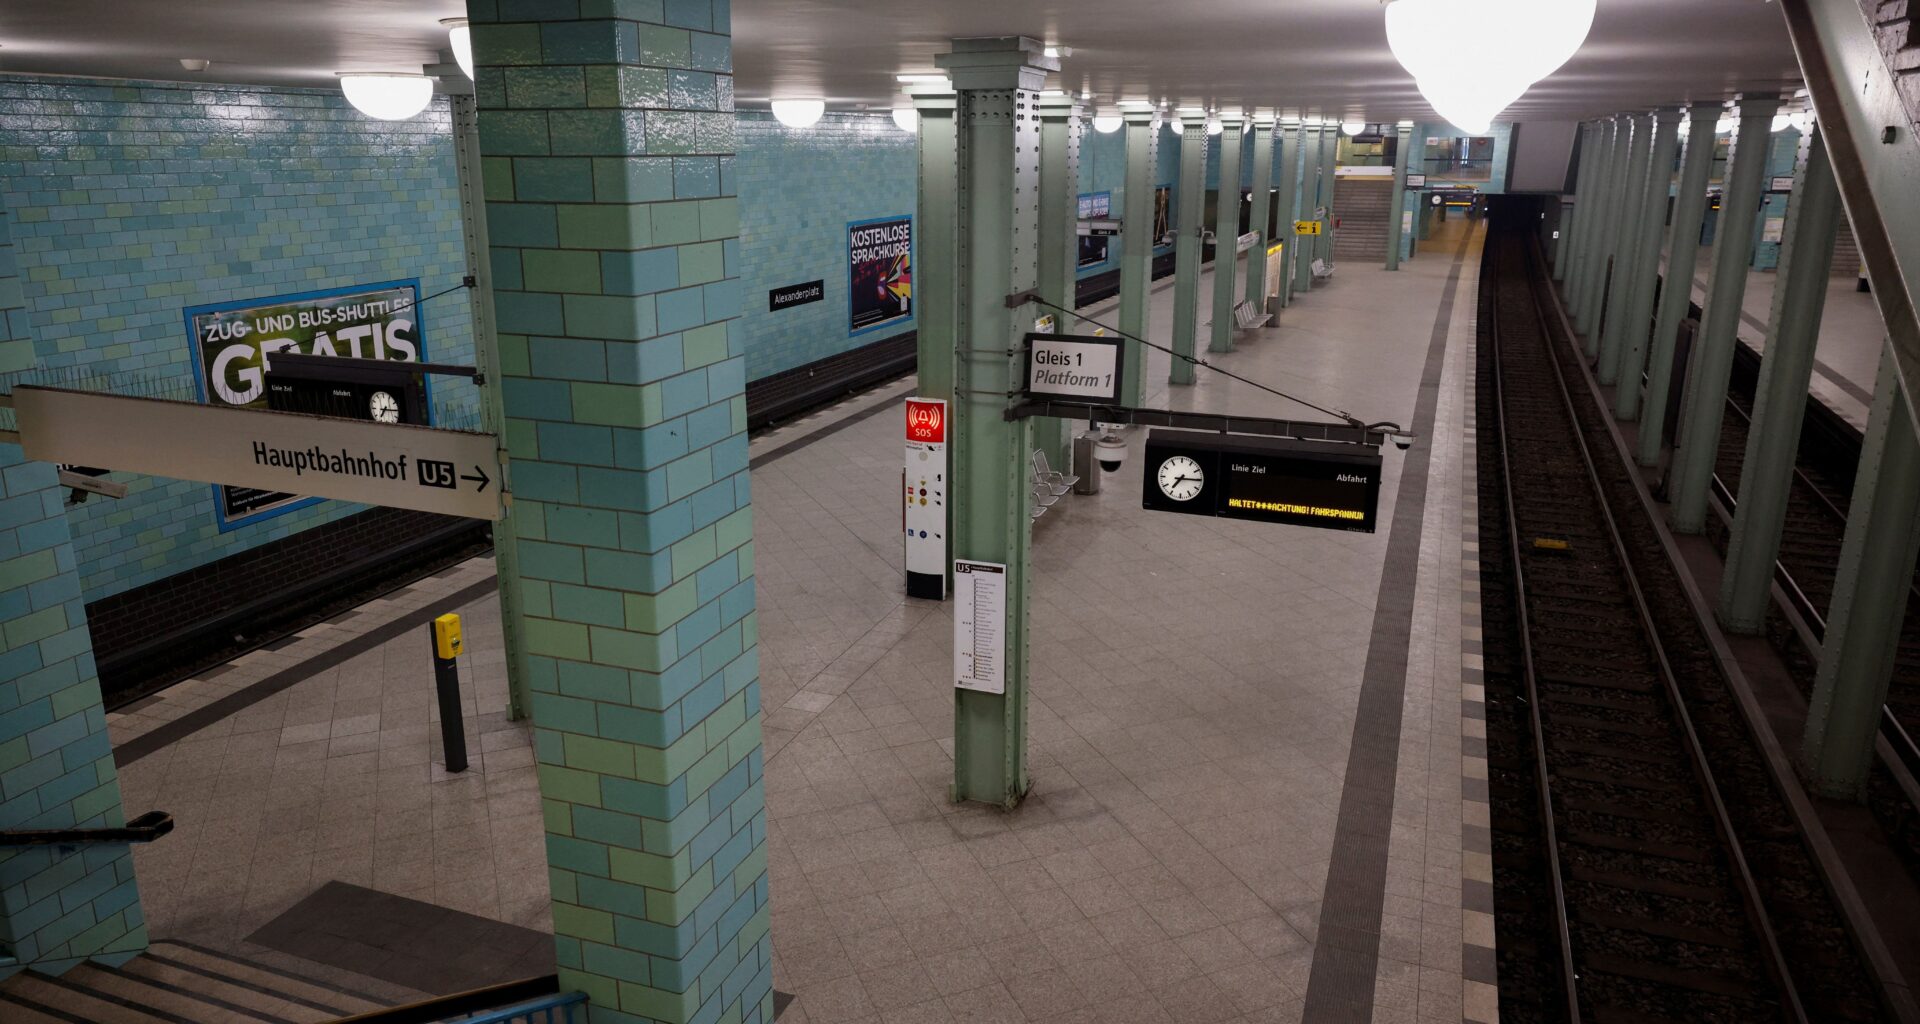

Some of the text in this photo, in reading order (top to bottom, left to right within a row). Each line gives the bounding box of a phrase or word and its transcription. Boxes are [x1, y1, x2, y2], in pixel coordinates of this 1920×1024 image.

[851, 224, 910, 248] KOSTENLOSE
[851, 241, 911, 265] SPRACHKURSE
[774, 286, 821, 306] Alexanderplatz
[205, 297, 411, 343] ZUG- UND BUS-SHUTTLES
[1035, 349, 1083, 367] Gleis 1
[1034, 369, 1112, 389] Platform 1
[914, 427, 932, 439] SOS
[253, 441, 454, 485] Hauptbahnhof U5
[1231, 463, 1367, 484] Linie Ziel Abfahrt
[957, 563, 970, 573] U5
